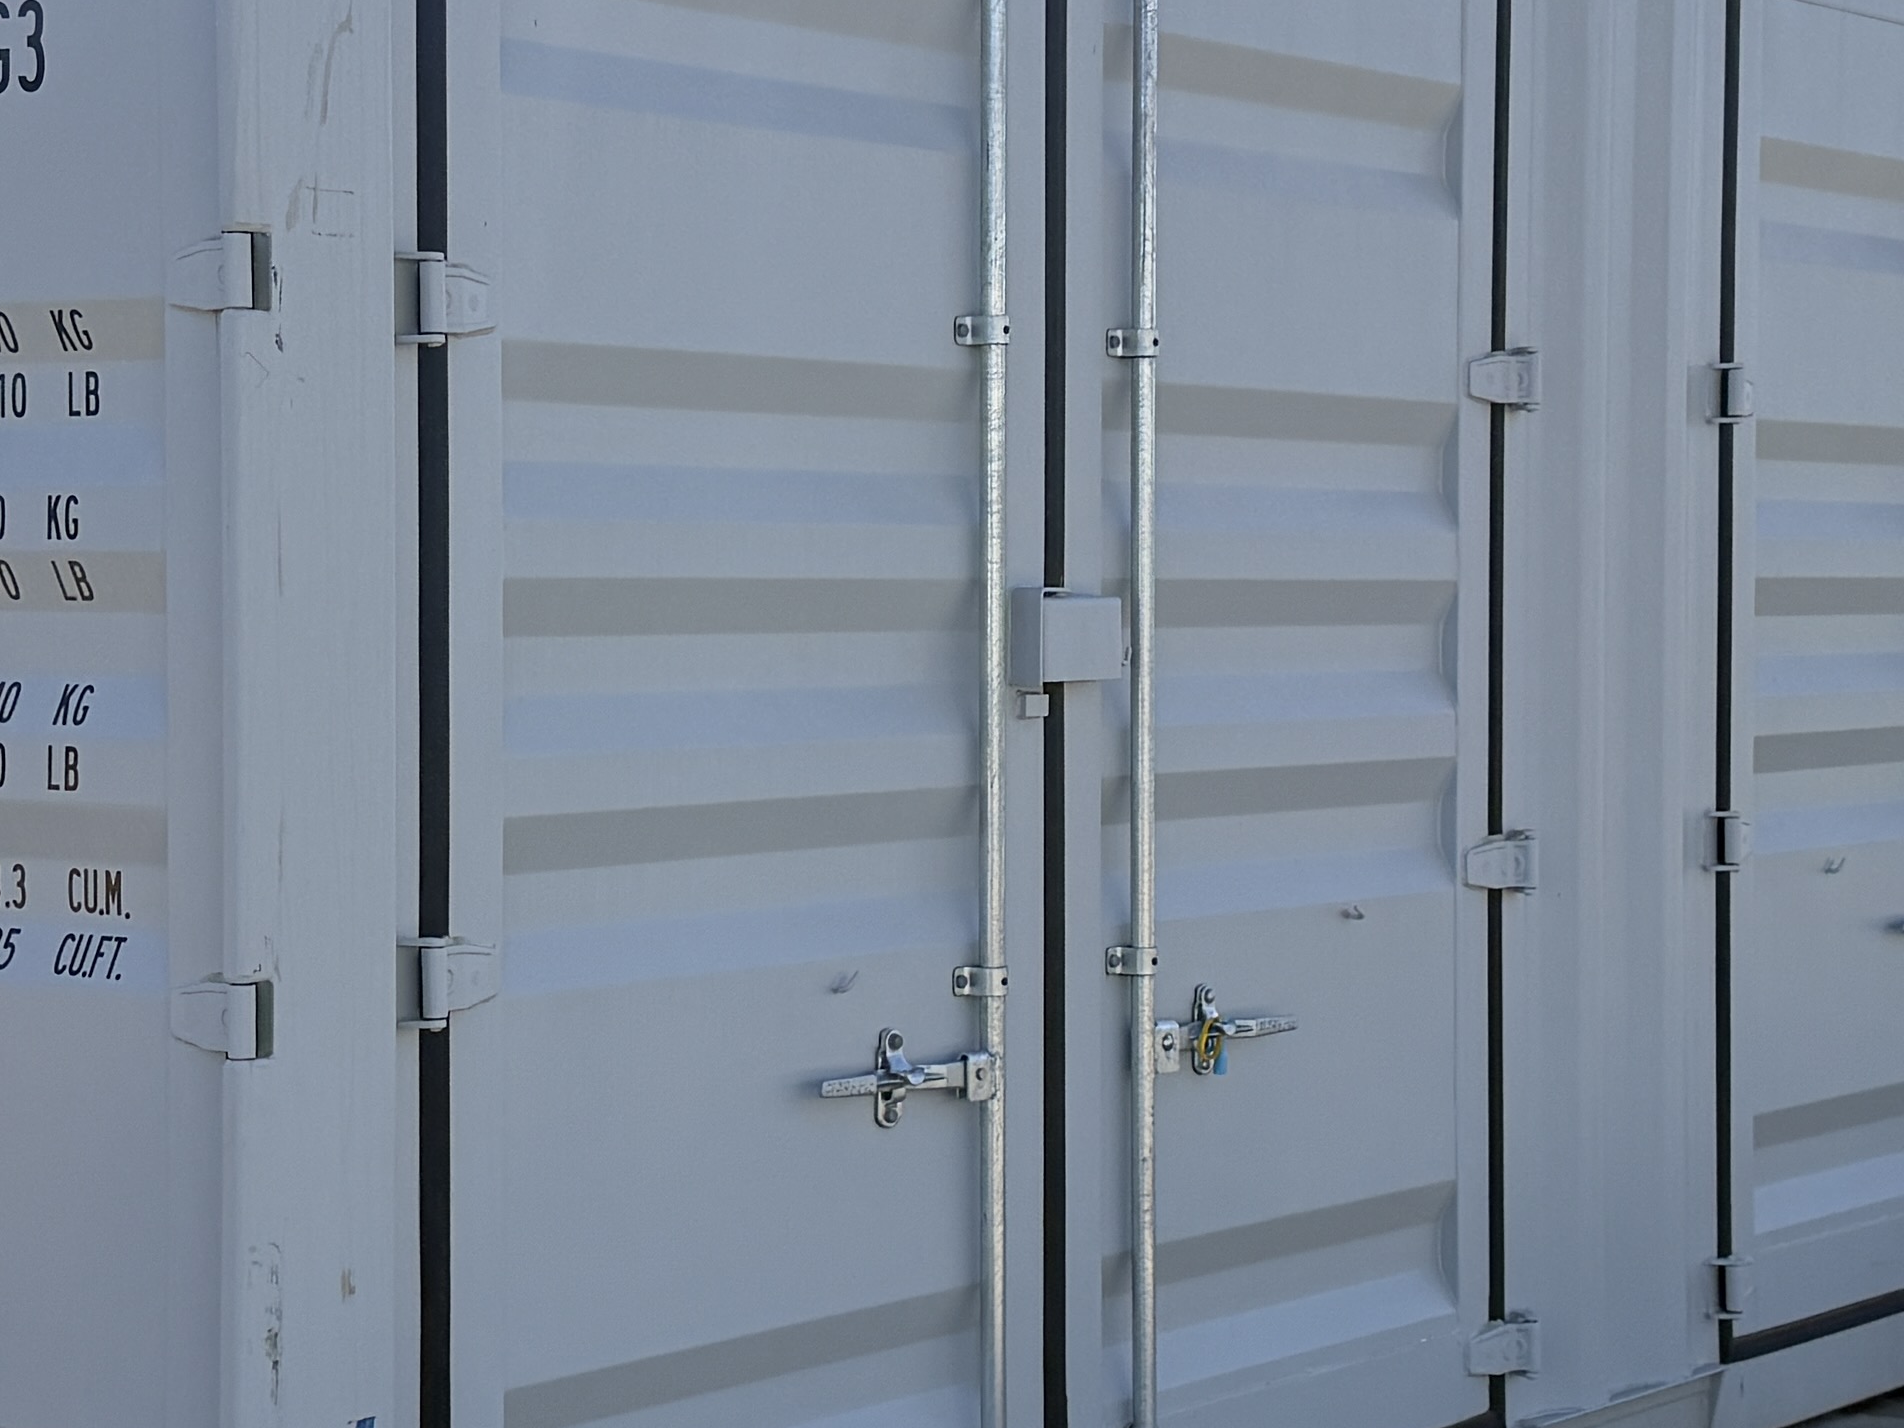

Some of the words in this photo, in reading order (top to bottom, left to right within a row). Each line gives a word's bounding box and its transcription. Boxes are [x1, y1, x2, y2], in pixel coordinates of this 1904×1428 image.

[49, 309, 93, 352] KG
[68, 370, 100, 417] LB
[47, 494, 79, 541] KG
[50, 560, 95, 602] LB
[52, 683, 95, 726] KG
[47, 744, 79, 792] LB
[68, 867, 131, 920] CU.M.
[53, 933, 128, 981] CU.FT.
